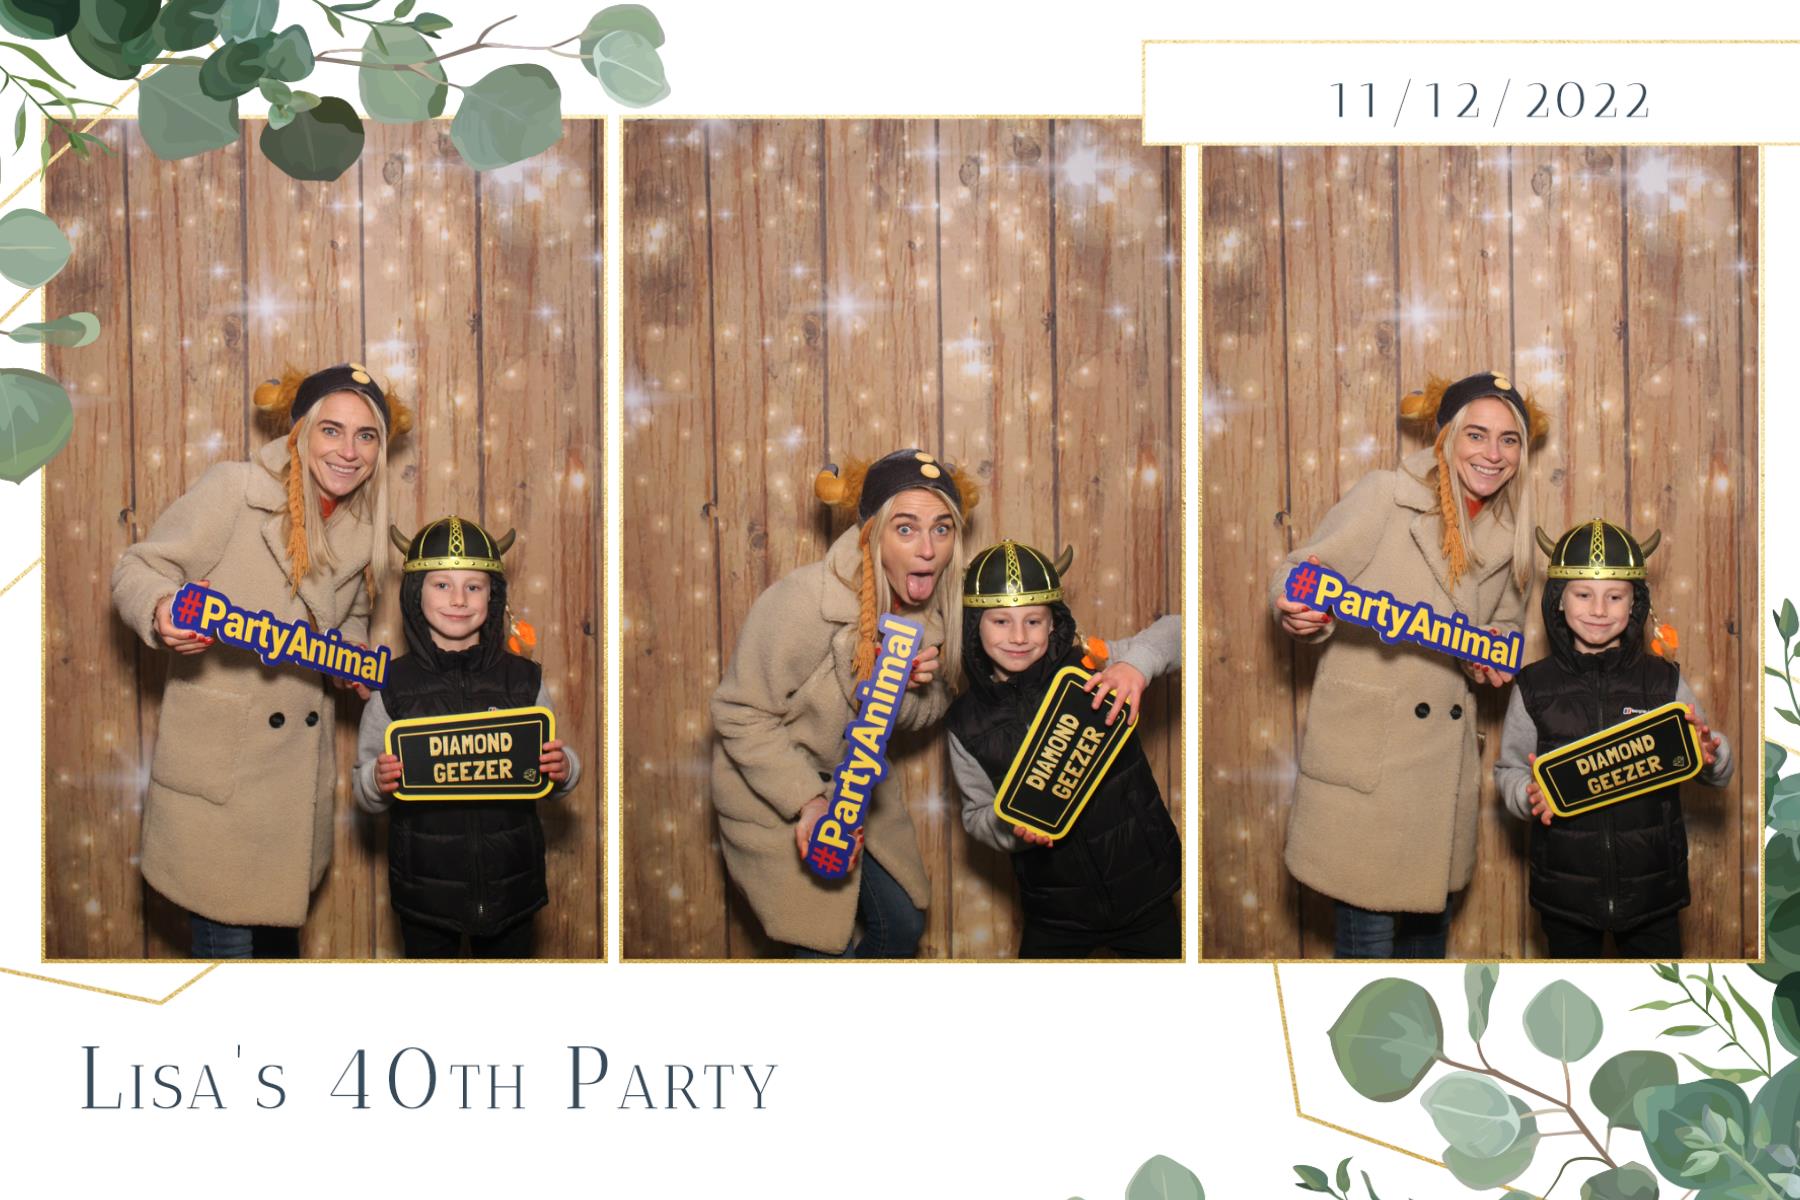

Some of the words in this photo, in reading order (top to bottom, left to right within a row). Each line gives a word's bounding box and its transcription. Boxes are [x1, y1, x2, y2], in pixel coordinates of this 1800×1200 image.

[177, 589, 388, 684] #PartyAnimal
[1291, 567, 1520, 669] #PartyAnimal
[429, 731, 513, 757] DIAMOND
[433, 758, 513, 784] GEEZER
[811, 619, 919, 873] #PartyAnimal
[1026, 713, 1080, 792] DIAMOND
[1051, 726, 1106, 800] GEEZER
[1576, 734, 1656, 776] DIAMOND
[1587, 755, 1663, 796] GEEZER
